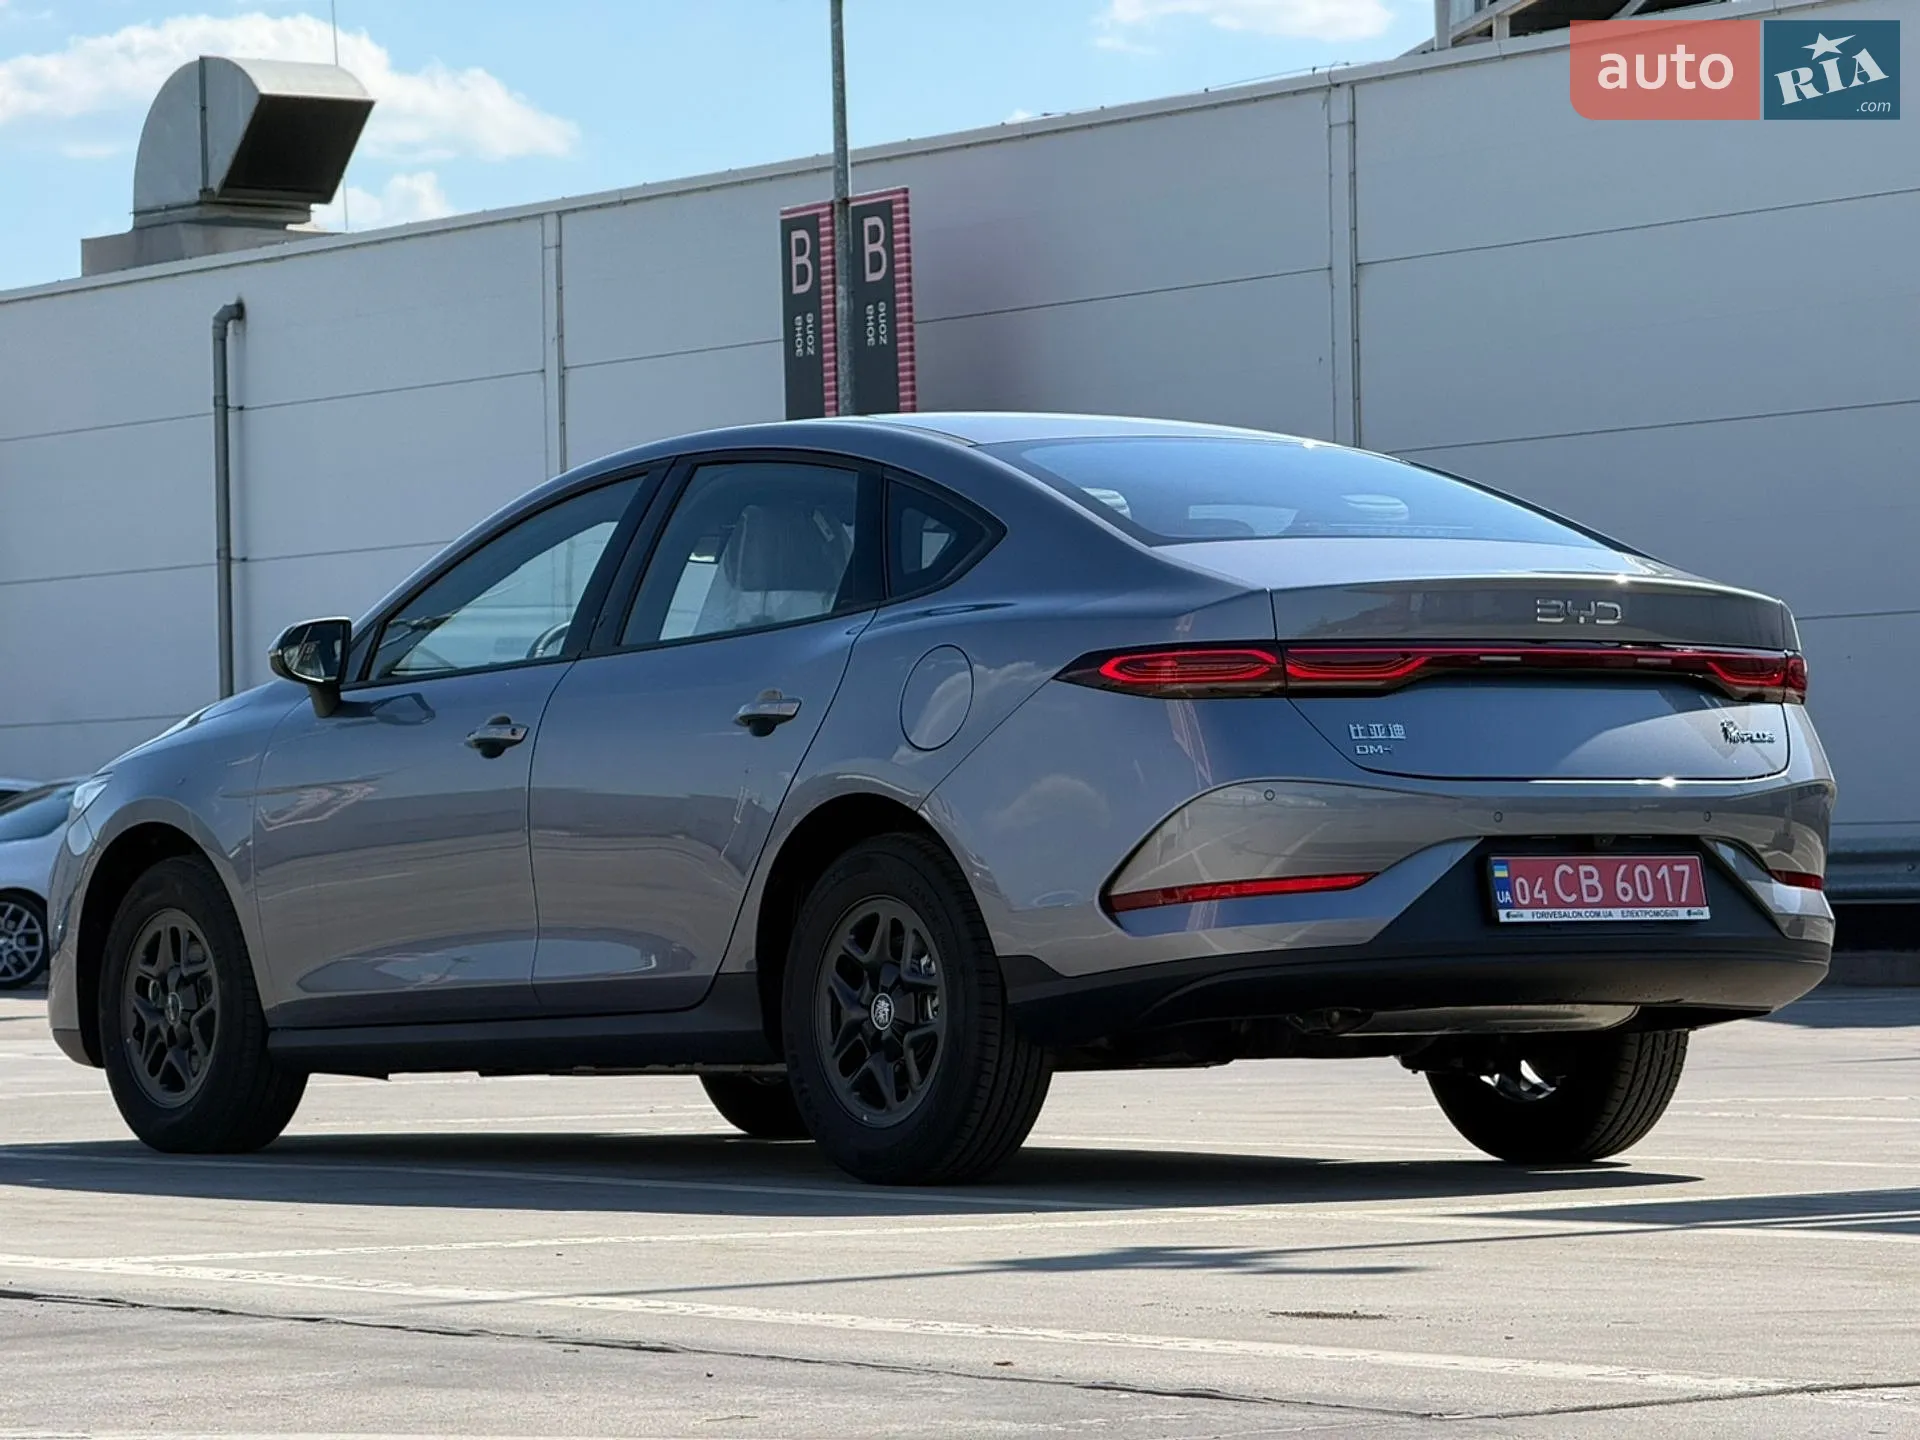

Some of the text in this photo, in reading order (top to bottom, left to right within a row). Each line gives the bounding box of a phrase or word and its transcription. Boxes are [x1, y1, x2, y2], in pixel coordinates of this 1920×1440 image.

[790, 229, 814, 294] B
[863, 216, 887, 282] B
[1536, 599, 1622, 625] BYD
[1349, 723, 1406, 740] 比亚迪
[1497, 890, 1512, 904] UA
[1615, 863, 1691, 903] 6017
